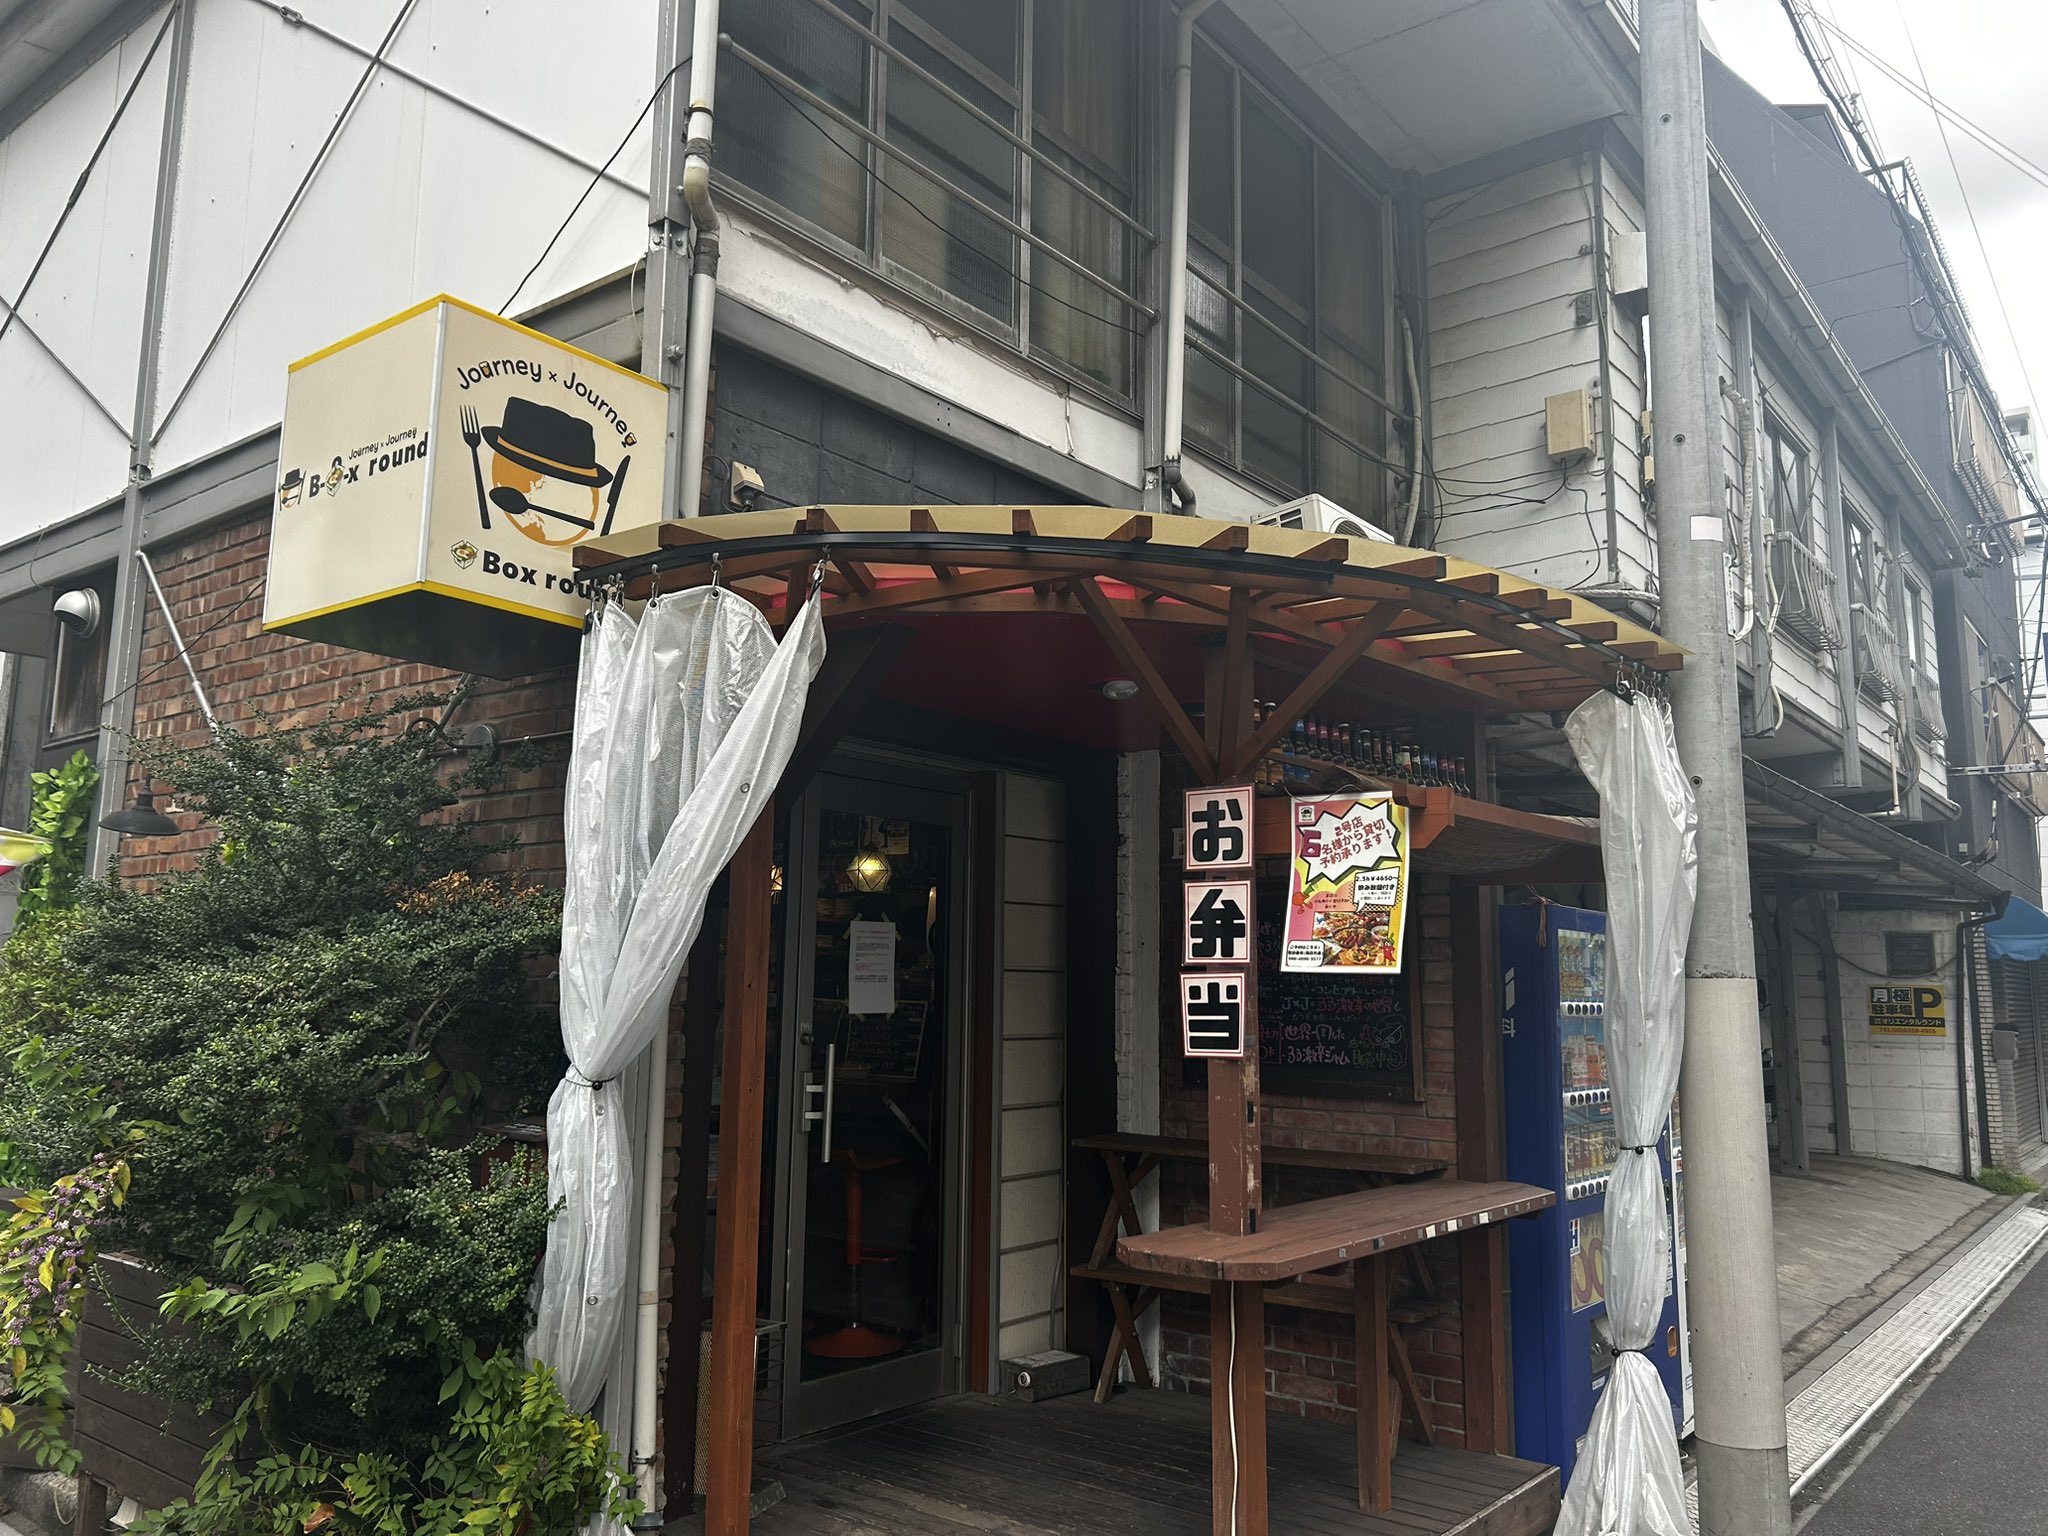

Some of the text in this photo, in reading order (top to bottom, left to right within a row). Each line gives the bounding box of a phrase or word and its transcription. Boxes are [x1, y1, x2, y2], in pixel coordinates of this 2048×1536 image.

[457, 358, 542, 390] Journey
[563, 372, 637, 449] Journey
[348, 442, 379, 460] Journey
[385, 427, 418, 446] Journey
[368, 431, 429, 477] round
[482, 549, 612, 604] Box rou
[1333, 815, 1364, 837] 2号店
[1872, 988, 1942, 1020] 月極 P
[1872, 1003, 1913, 1015] 駐車場
